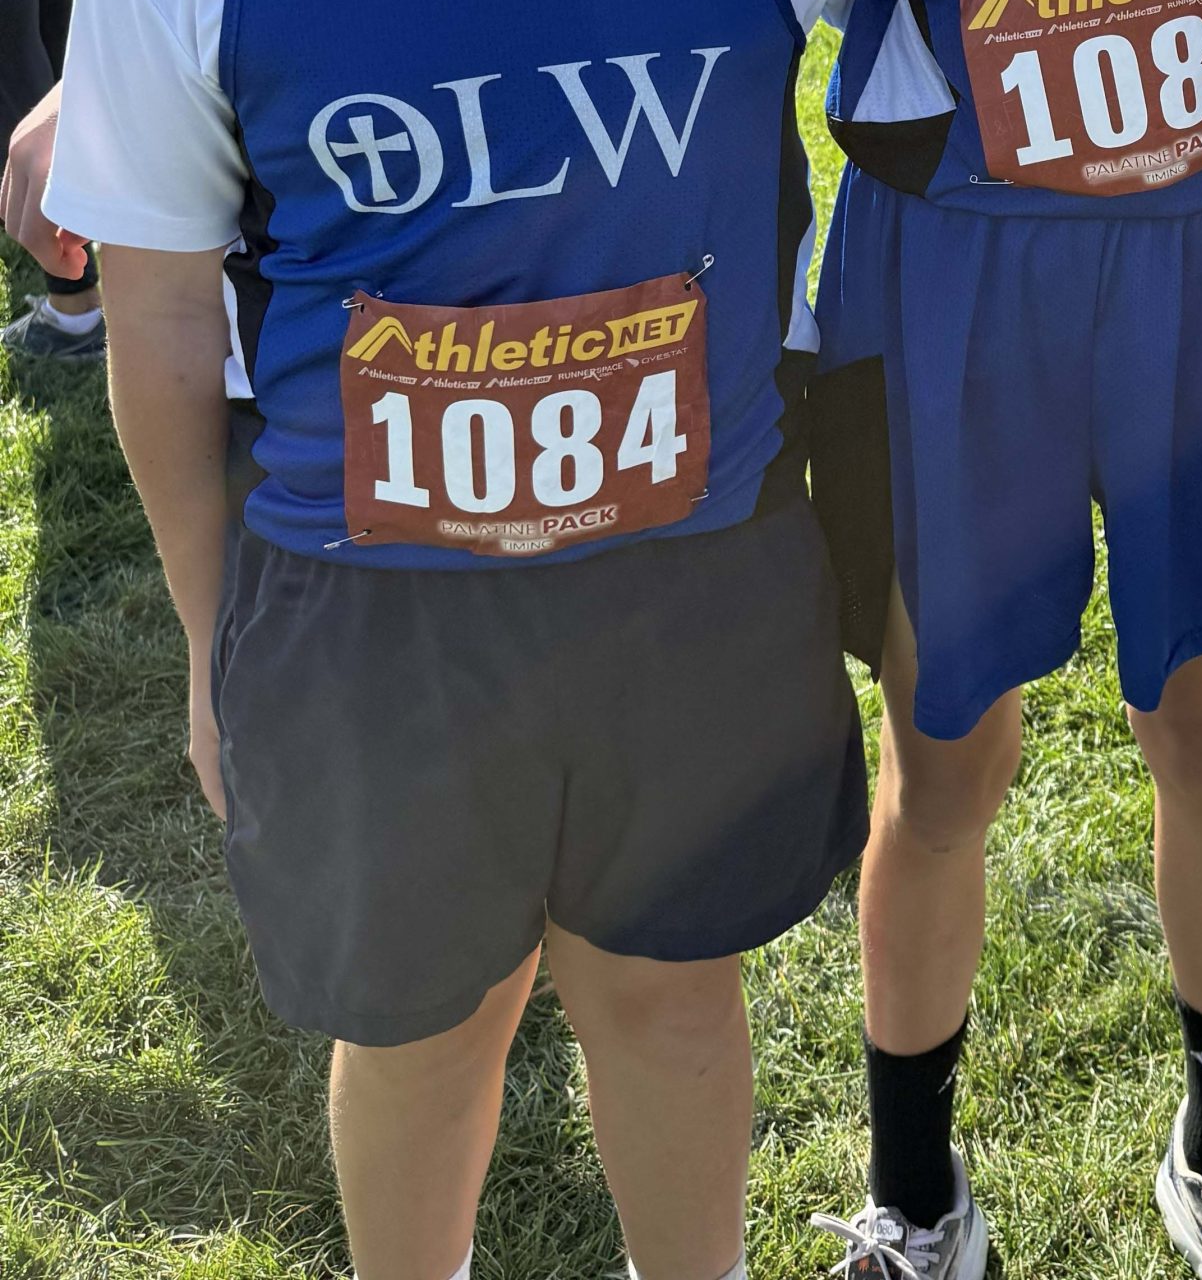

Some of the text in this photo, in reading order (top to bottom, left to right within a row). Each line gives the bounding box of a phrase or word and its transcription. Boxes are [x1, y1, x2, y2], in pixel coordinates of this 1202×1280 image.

[308, 46, 731, 214] OLW
[1085, 149, 1172, 178] PALATINE
[1145, 163, 1188, 183] TIMING
[371, 369, 687, 513] 1084
[441, 507, 616, 535] PALATINE PACK
[503, 539, 552, 551] TIMING
